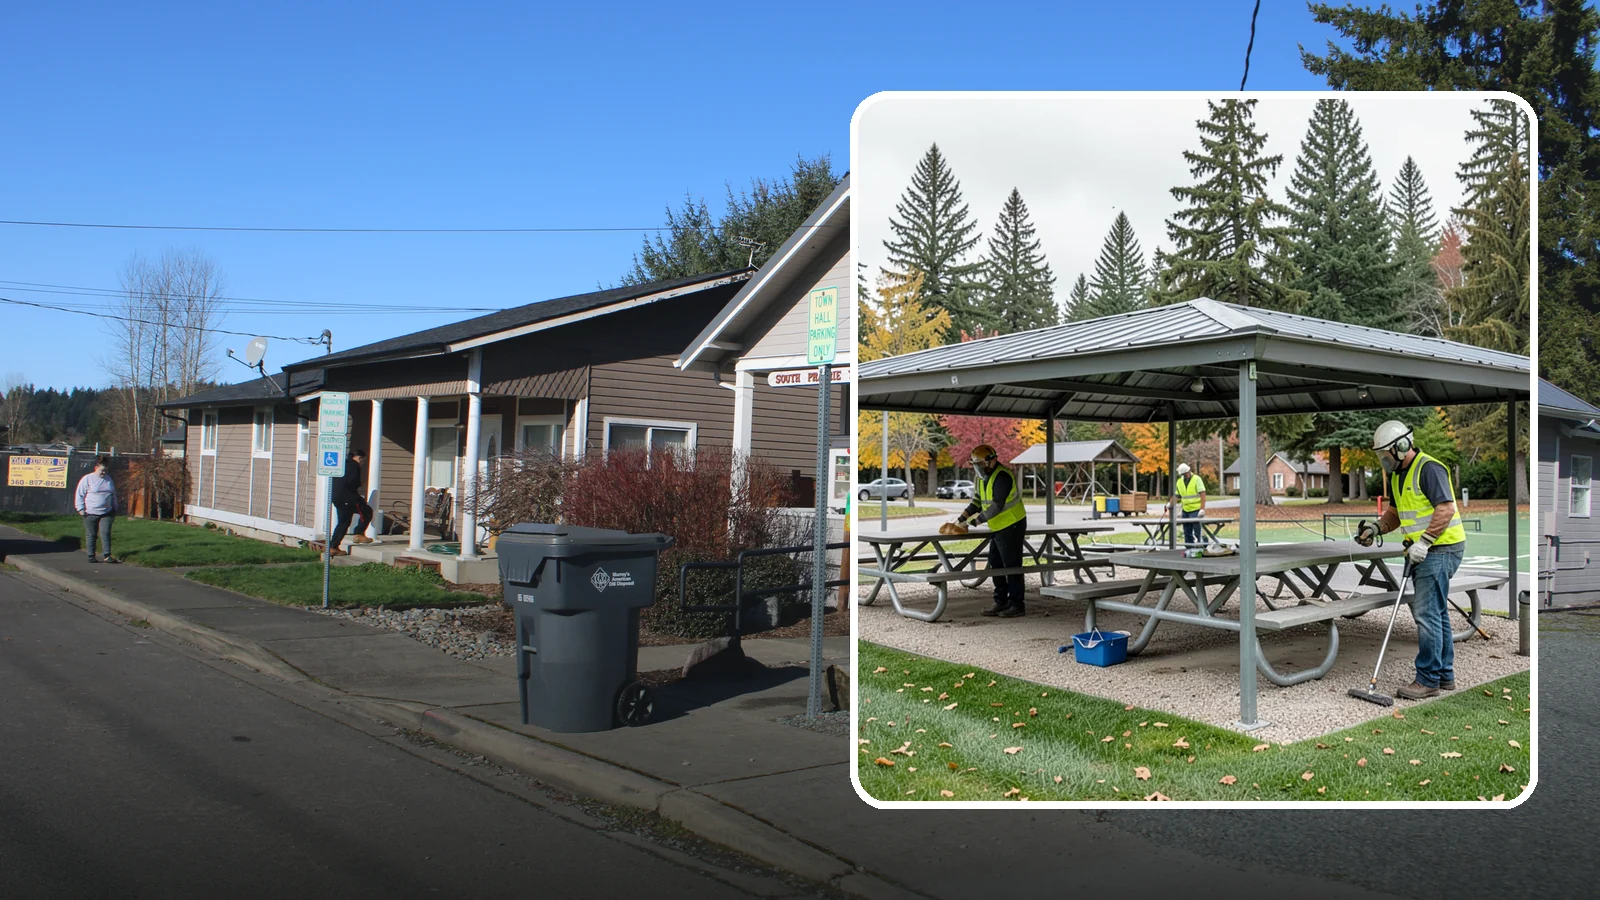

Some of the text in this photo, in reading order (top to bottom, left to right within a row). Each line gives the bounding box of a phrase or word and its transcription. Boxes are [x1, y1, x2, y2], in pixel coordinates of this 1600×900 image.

[815, 294, 833, 308] TOWN
[814, 312, 830, 324] HALL
[810, 326, 836, 341] PARKING
[813, 344, 830, 357] ONLY
[775, 373, 801, 384] SOUTH
[326, 420, 340, 428] ONLY
